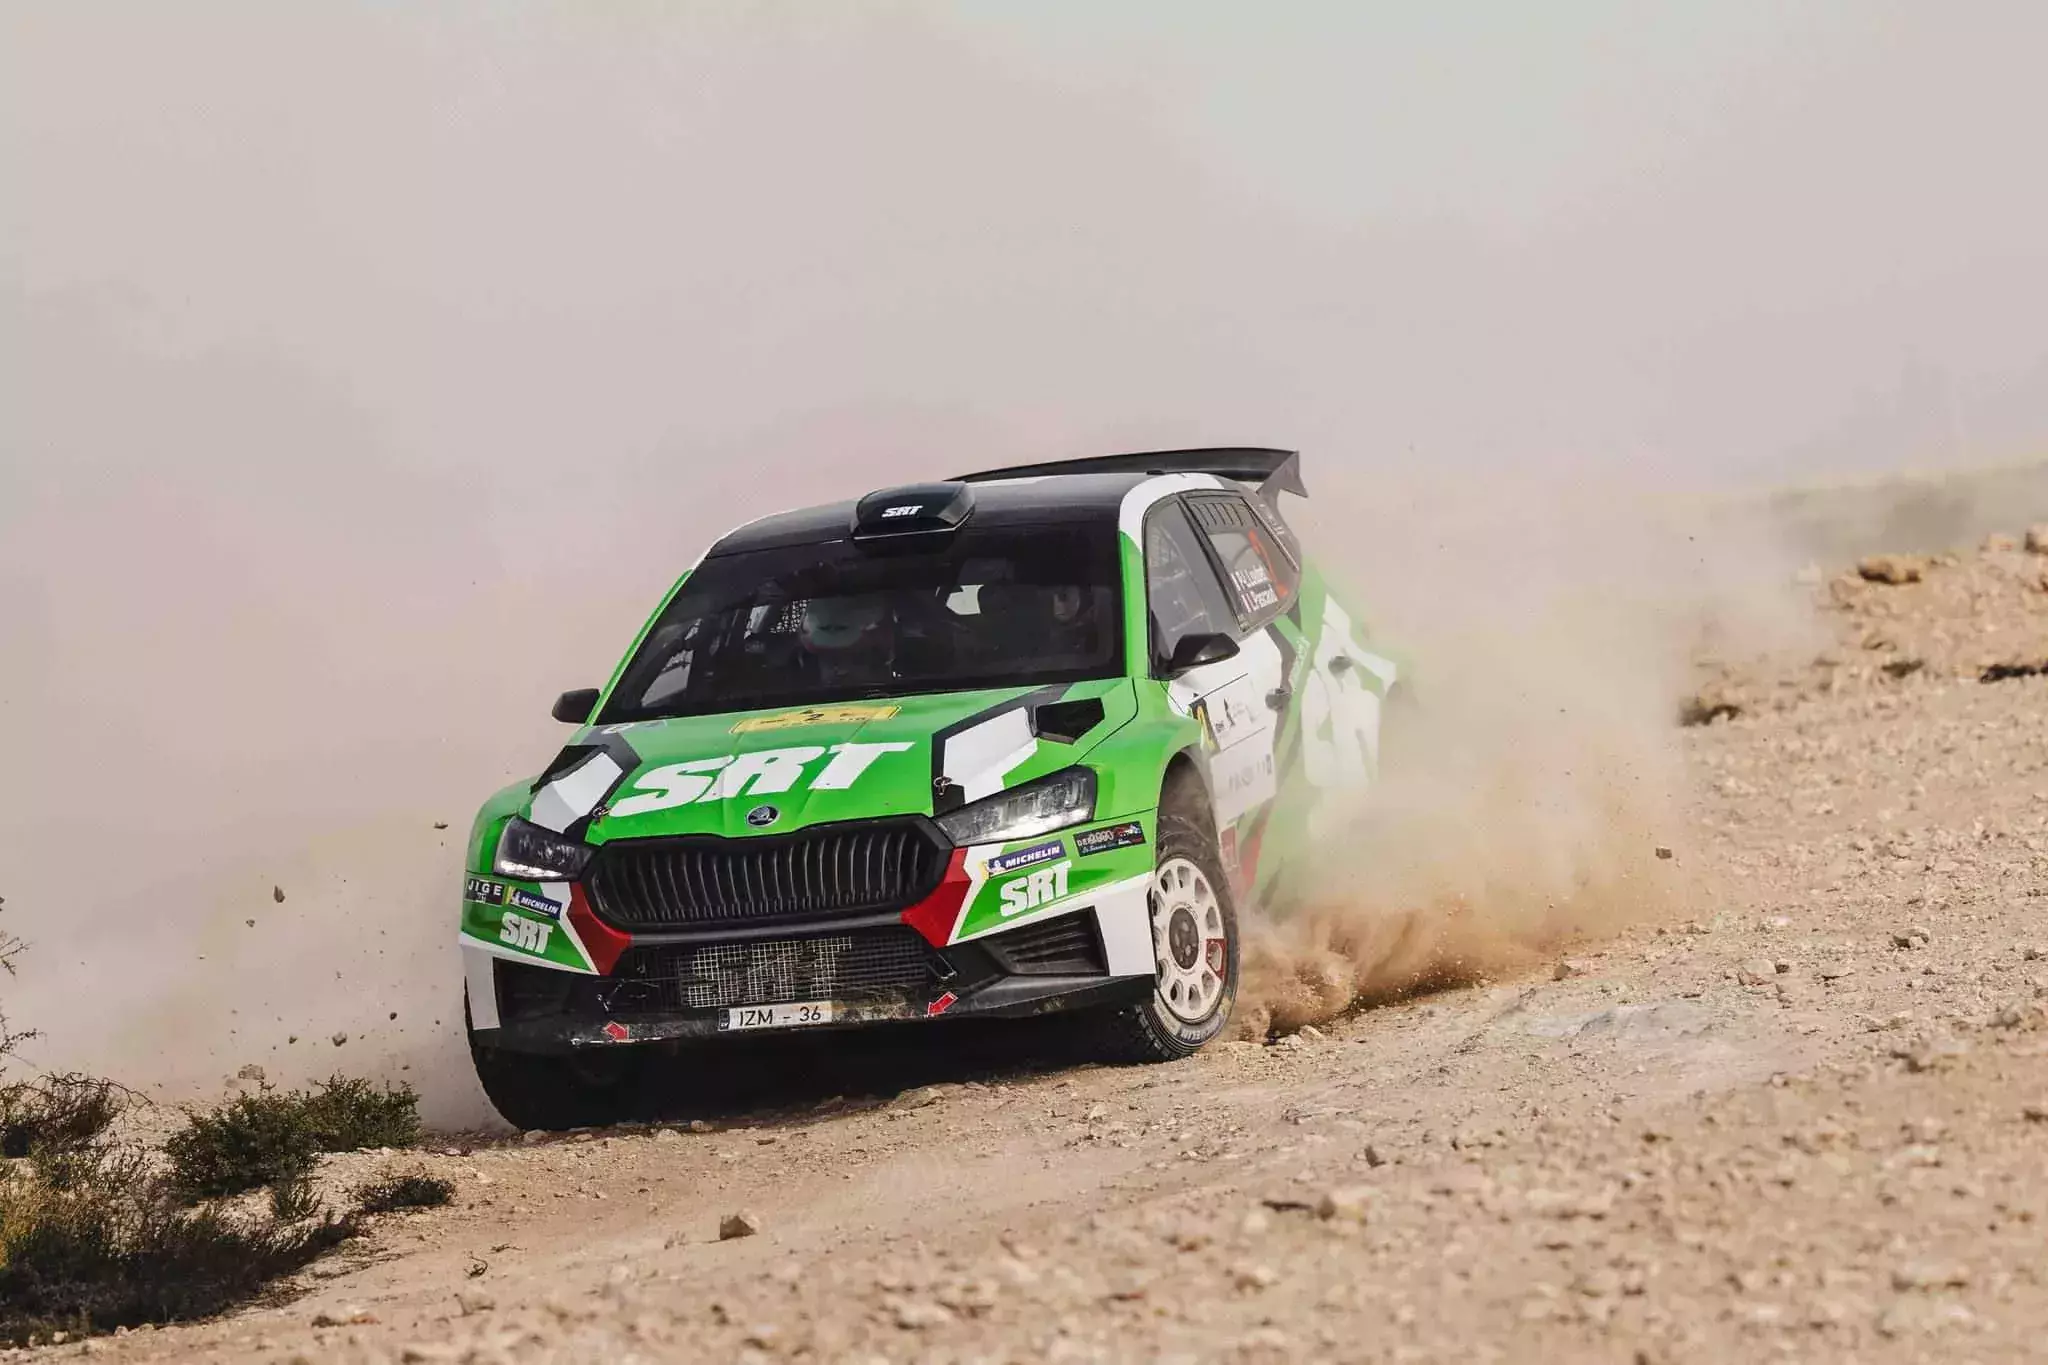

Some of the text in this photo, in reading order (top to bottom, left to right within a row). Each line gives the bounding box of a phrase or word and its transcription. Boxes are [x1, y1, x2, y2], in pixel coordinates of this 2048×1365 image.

[881, 504, 924, 518] SRT
[609, 742, 916, 817] SRT
[1005, 845, 1060, 869] MICHELIN
[1000, 860, 1072, 917] SRT
[521, 896, 559, 914] MICHELIN
[500, 911, 554, 954] SRT
[740, 1009, 773, 1026] IZM
[799, 1006, 821, 1022] 36
